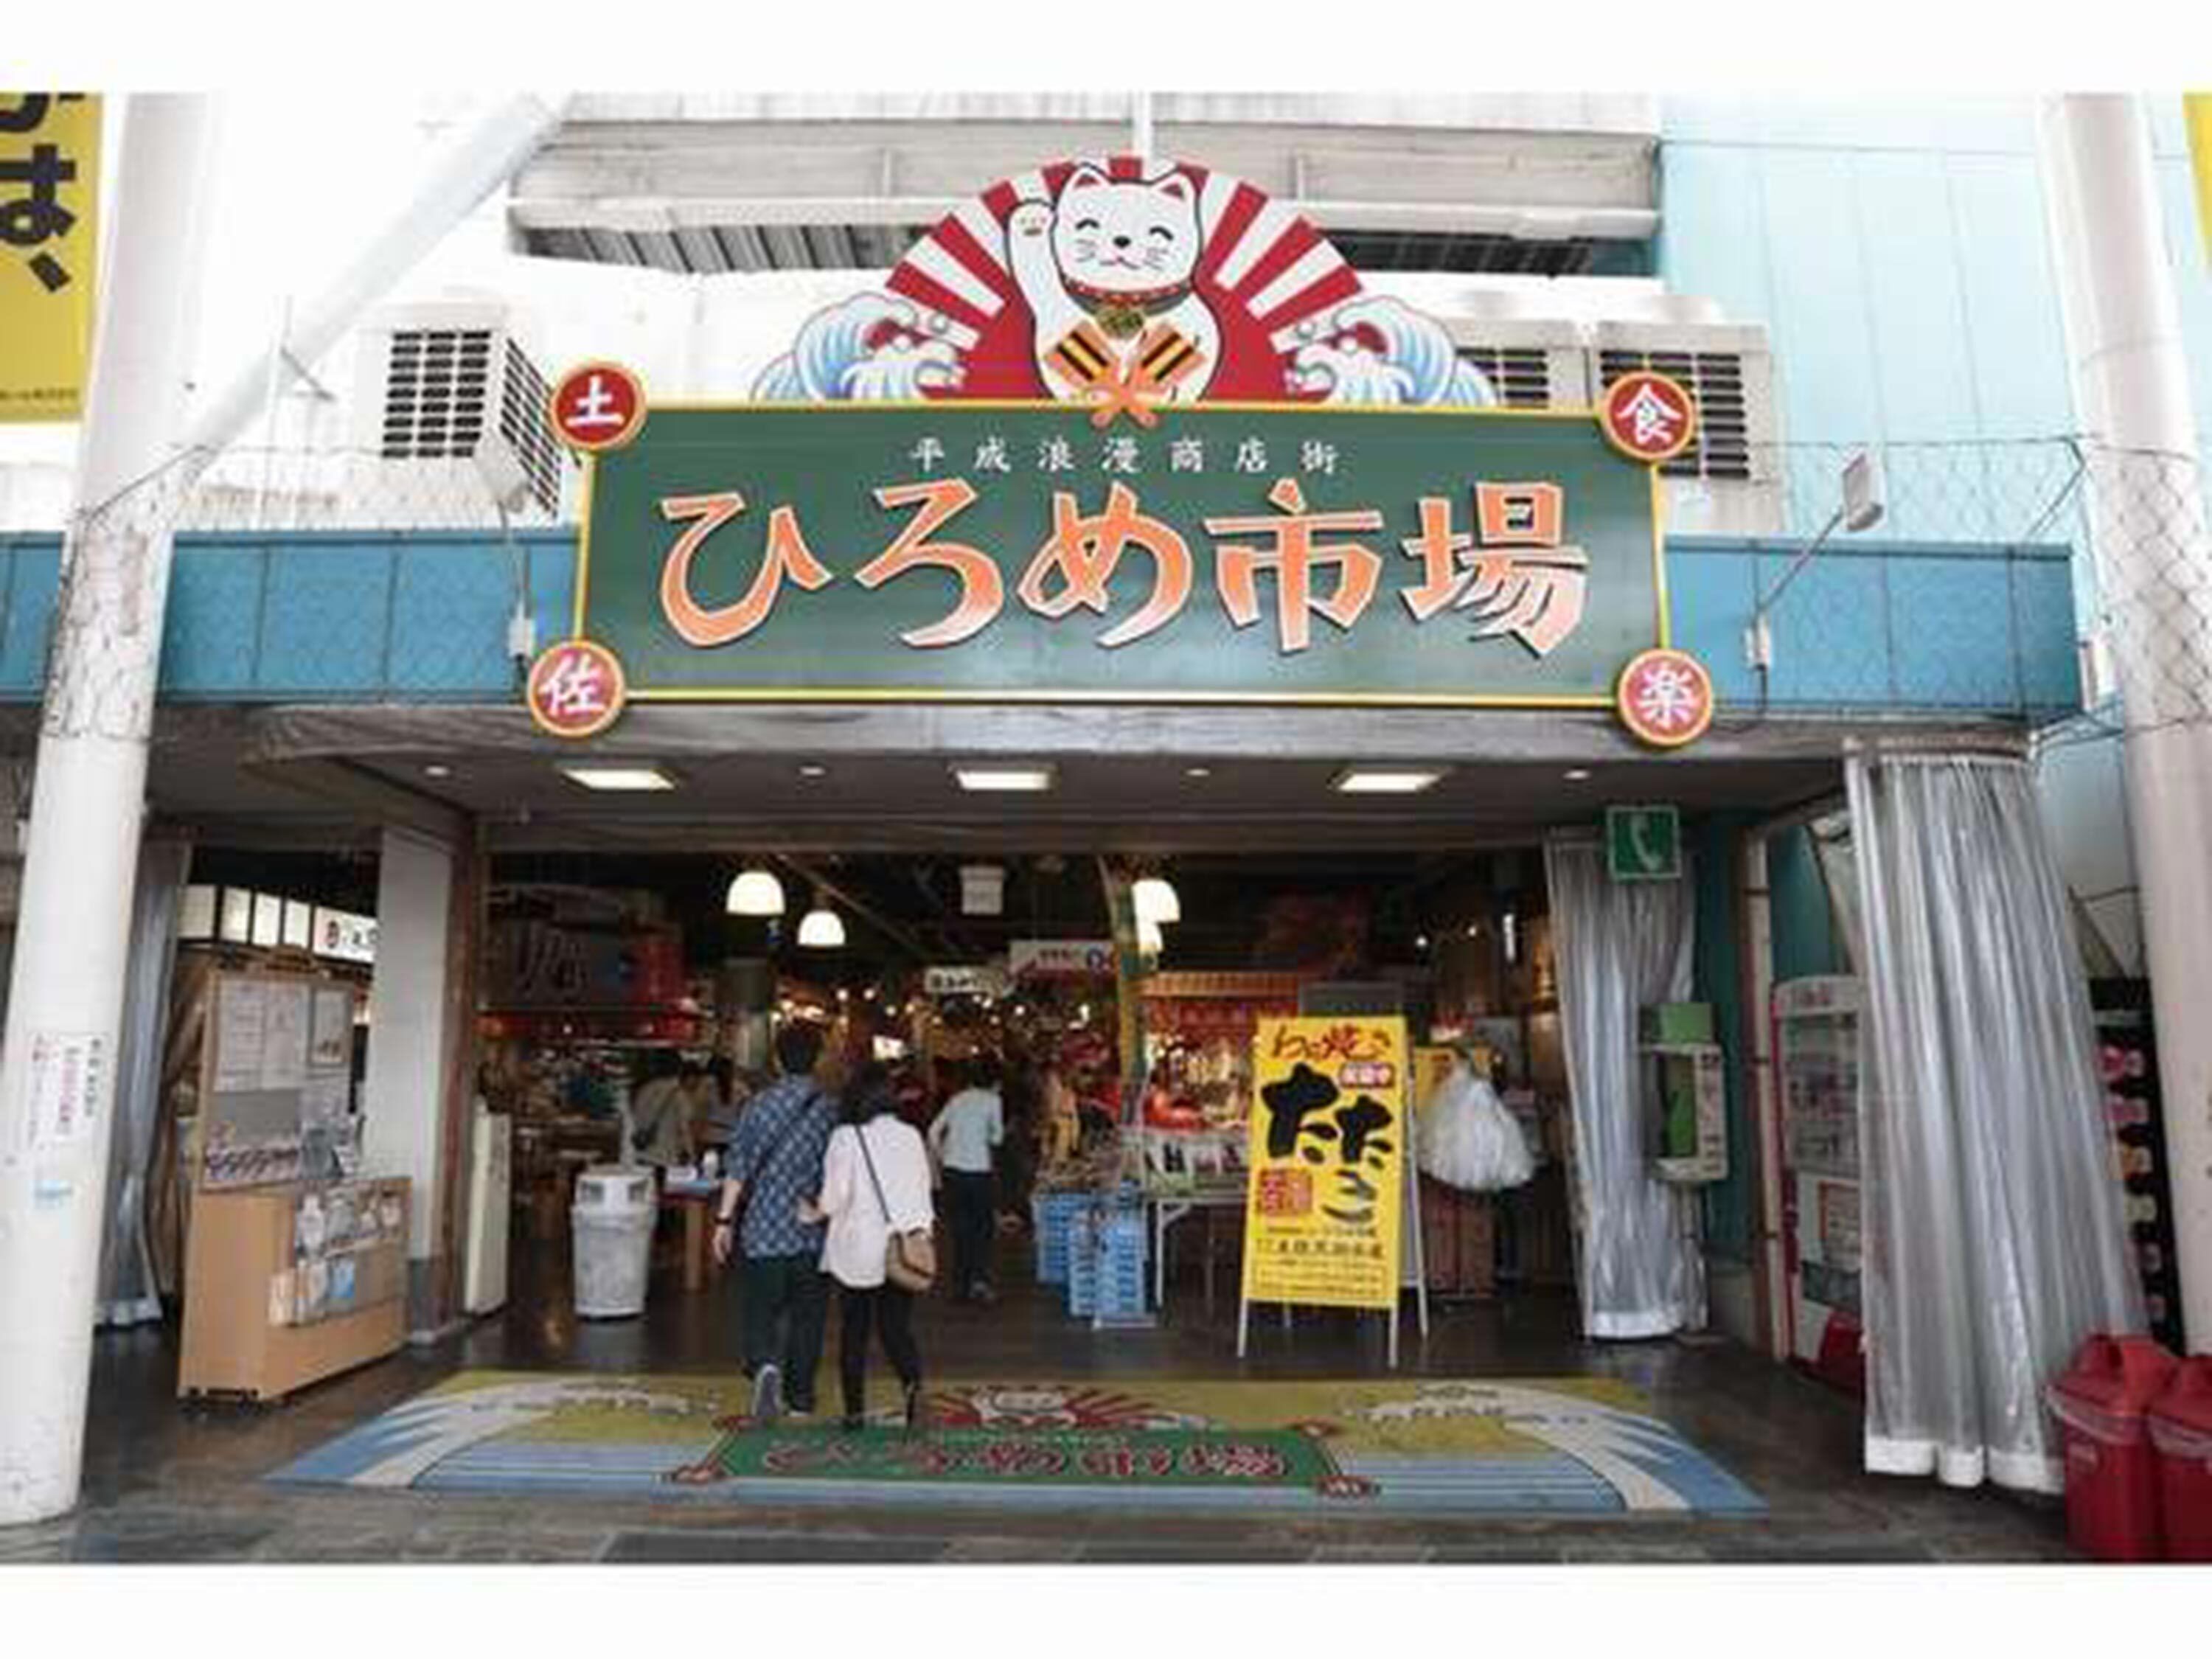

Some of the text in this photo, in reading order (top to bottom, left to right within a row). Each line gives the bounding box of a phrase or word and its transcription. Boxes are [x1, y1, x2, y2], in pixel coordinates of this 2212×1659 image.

[566, 375, 625, 428] 土
[1617, 382, 1683, 445] 食
[909, 436, 1342, 474] 平成浪漫商店街
[658, 476, 1589, 658] ひろめ市場
[540, 653, 605, 717] 佐
[1639, 666, 1702, 727] 楽
